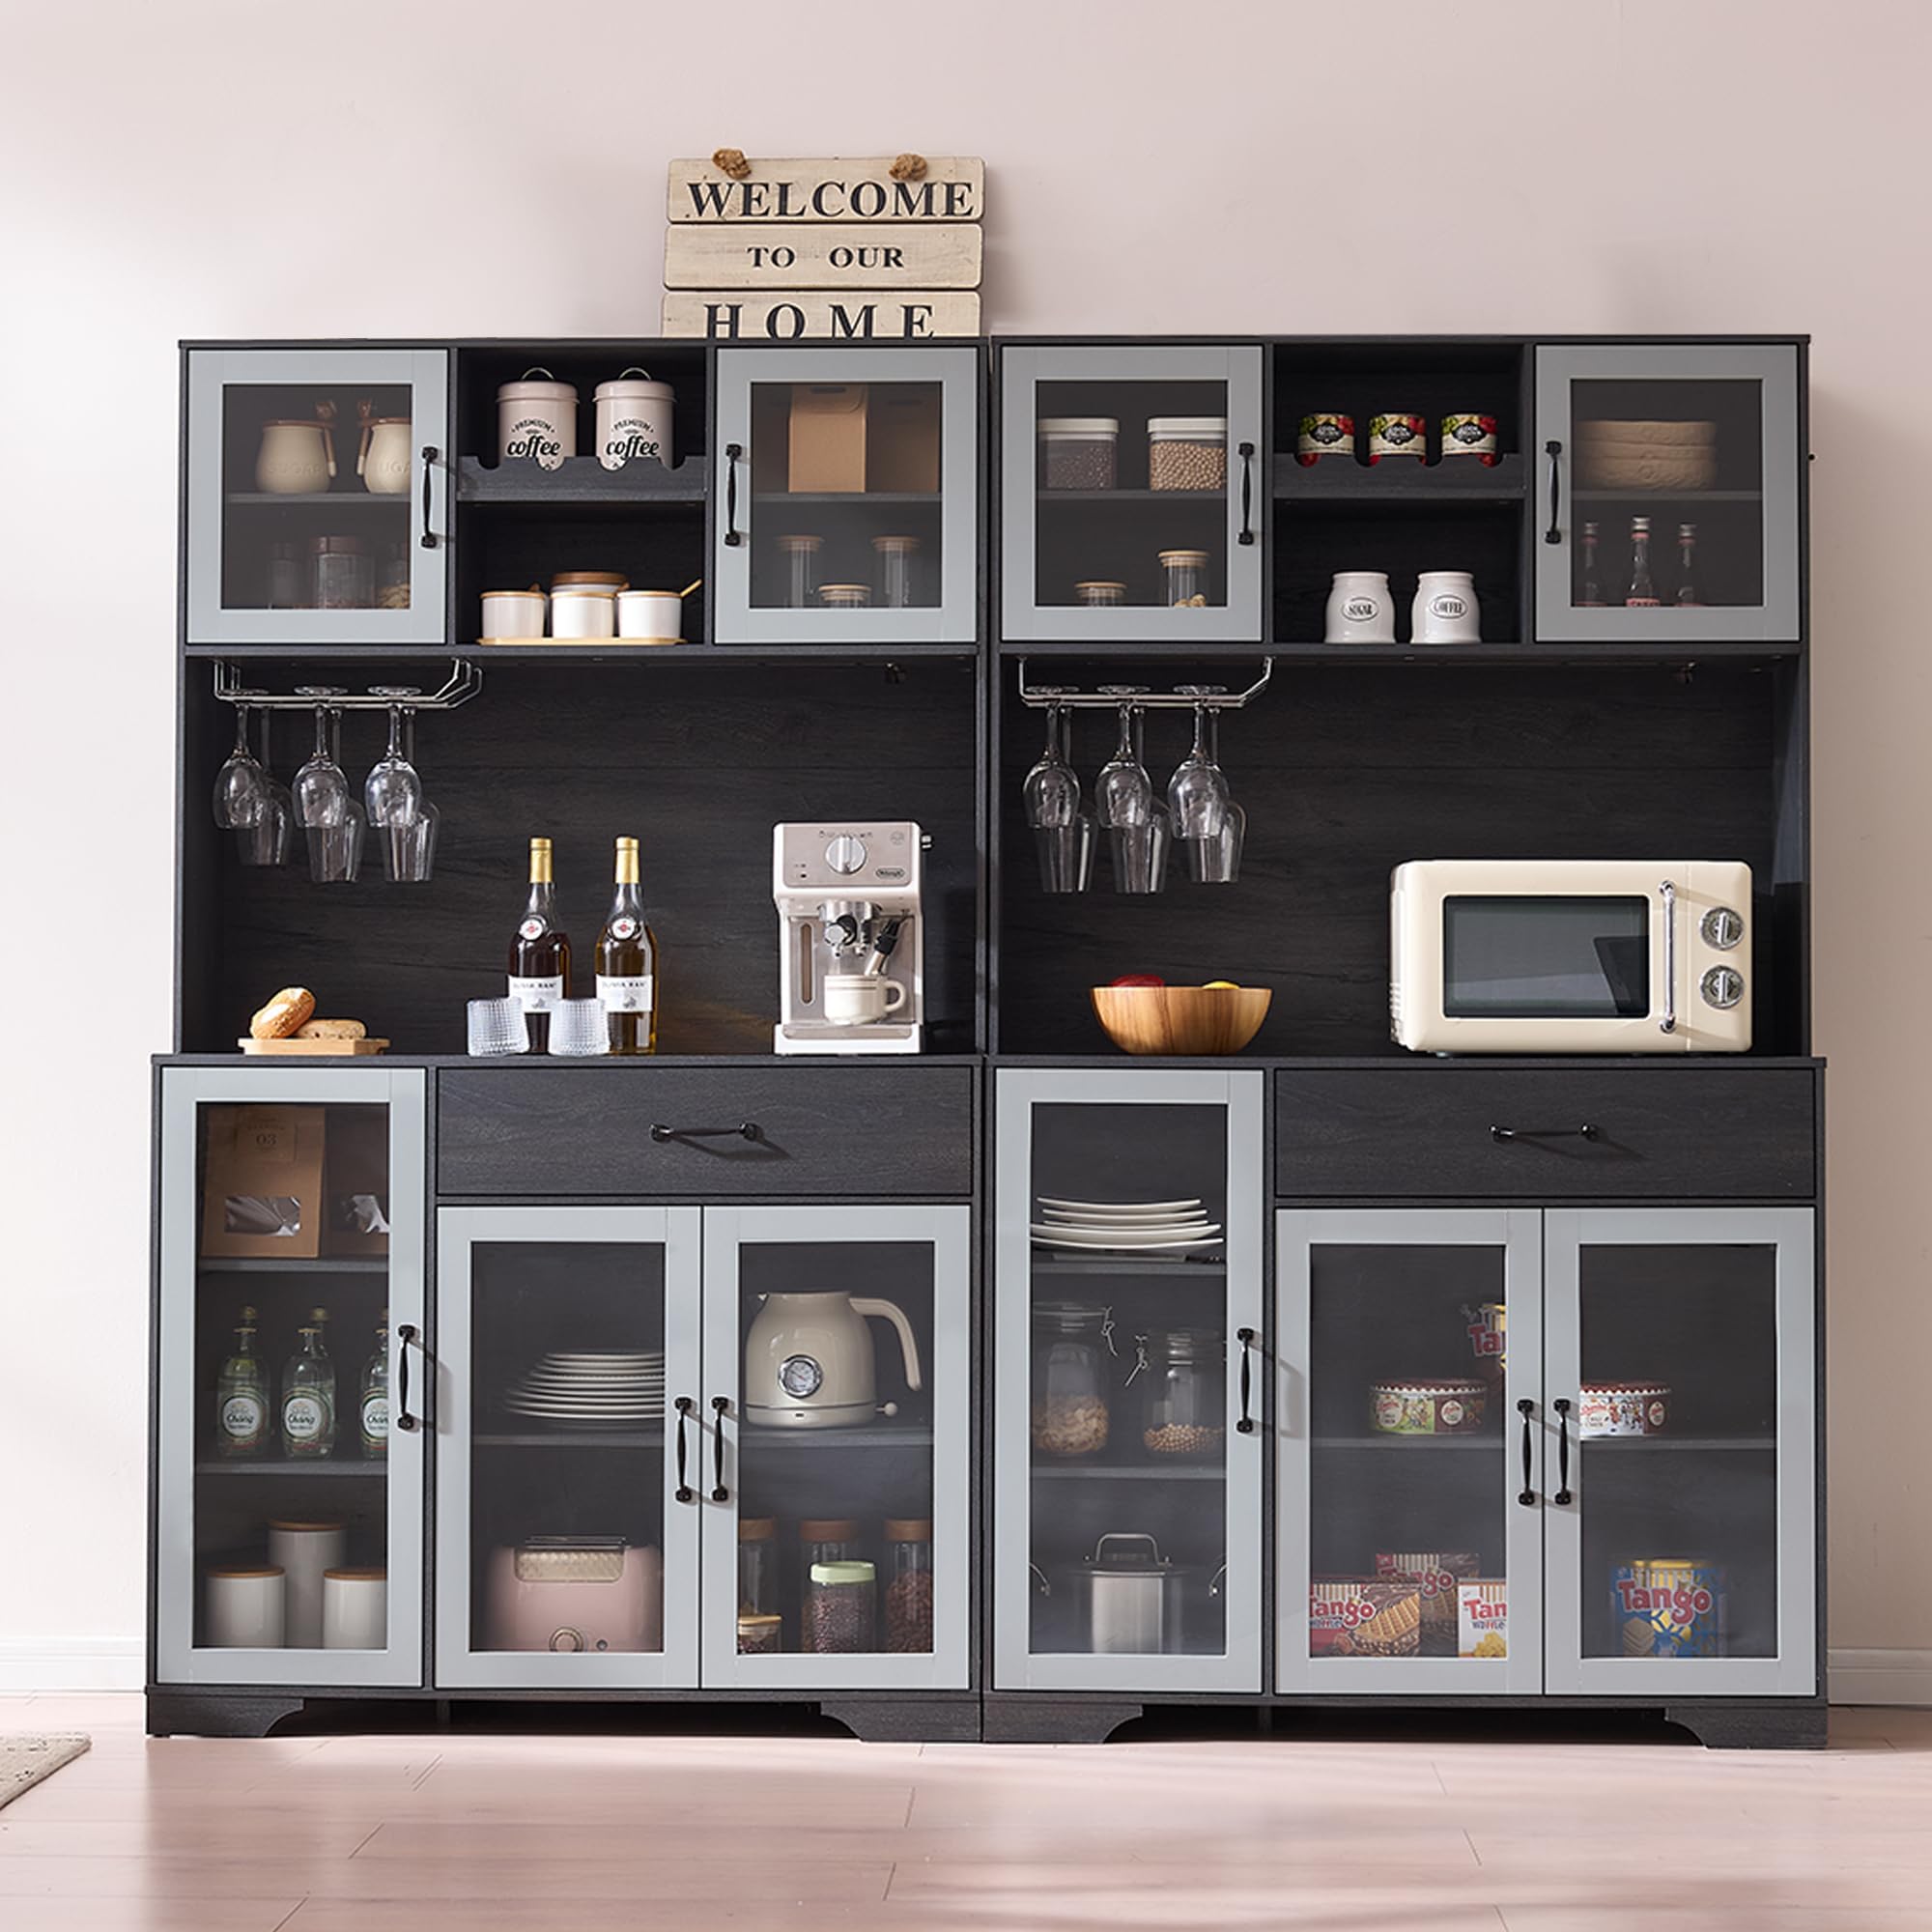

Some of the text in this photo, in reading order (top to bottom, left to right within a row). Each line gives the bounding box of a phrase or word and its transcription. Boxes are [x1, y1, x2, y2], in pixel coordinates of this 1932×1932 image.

[687, 181, 975, 218] WELCOME
[747, 246, 905, 269] TO OUR
[703, 302, 934, 338] HOME
[514, 418, 552, 432] PREMIUM
[613, 418, 650, 432] PREMIUM
[507, 435, 560, 457] coffee
[606, 435, 659, 460] coffee
[1463, 1599, 1507, 1620] Tan
[1618, 1580, 1711, 1625] Tango
